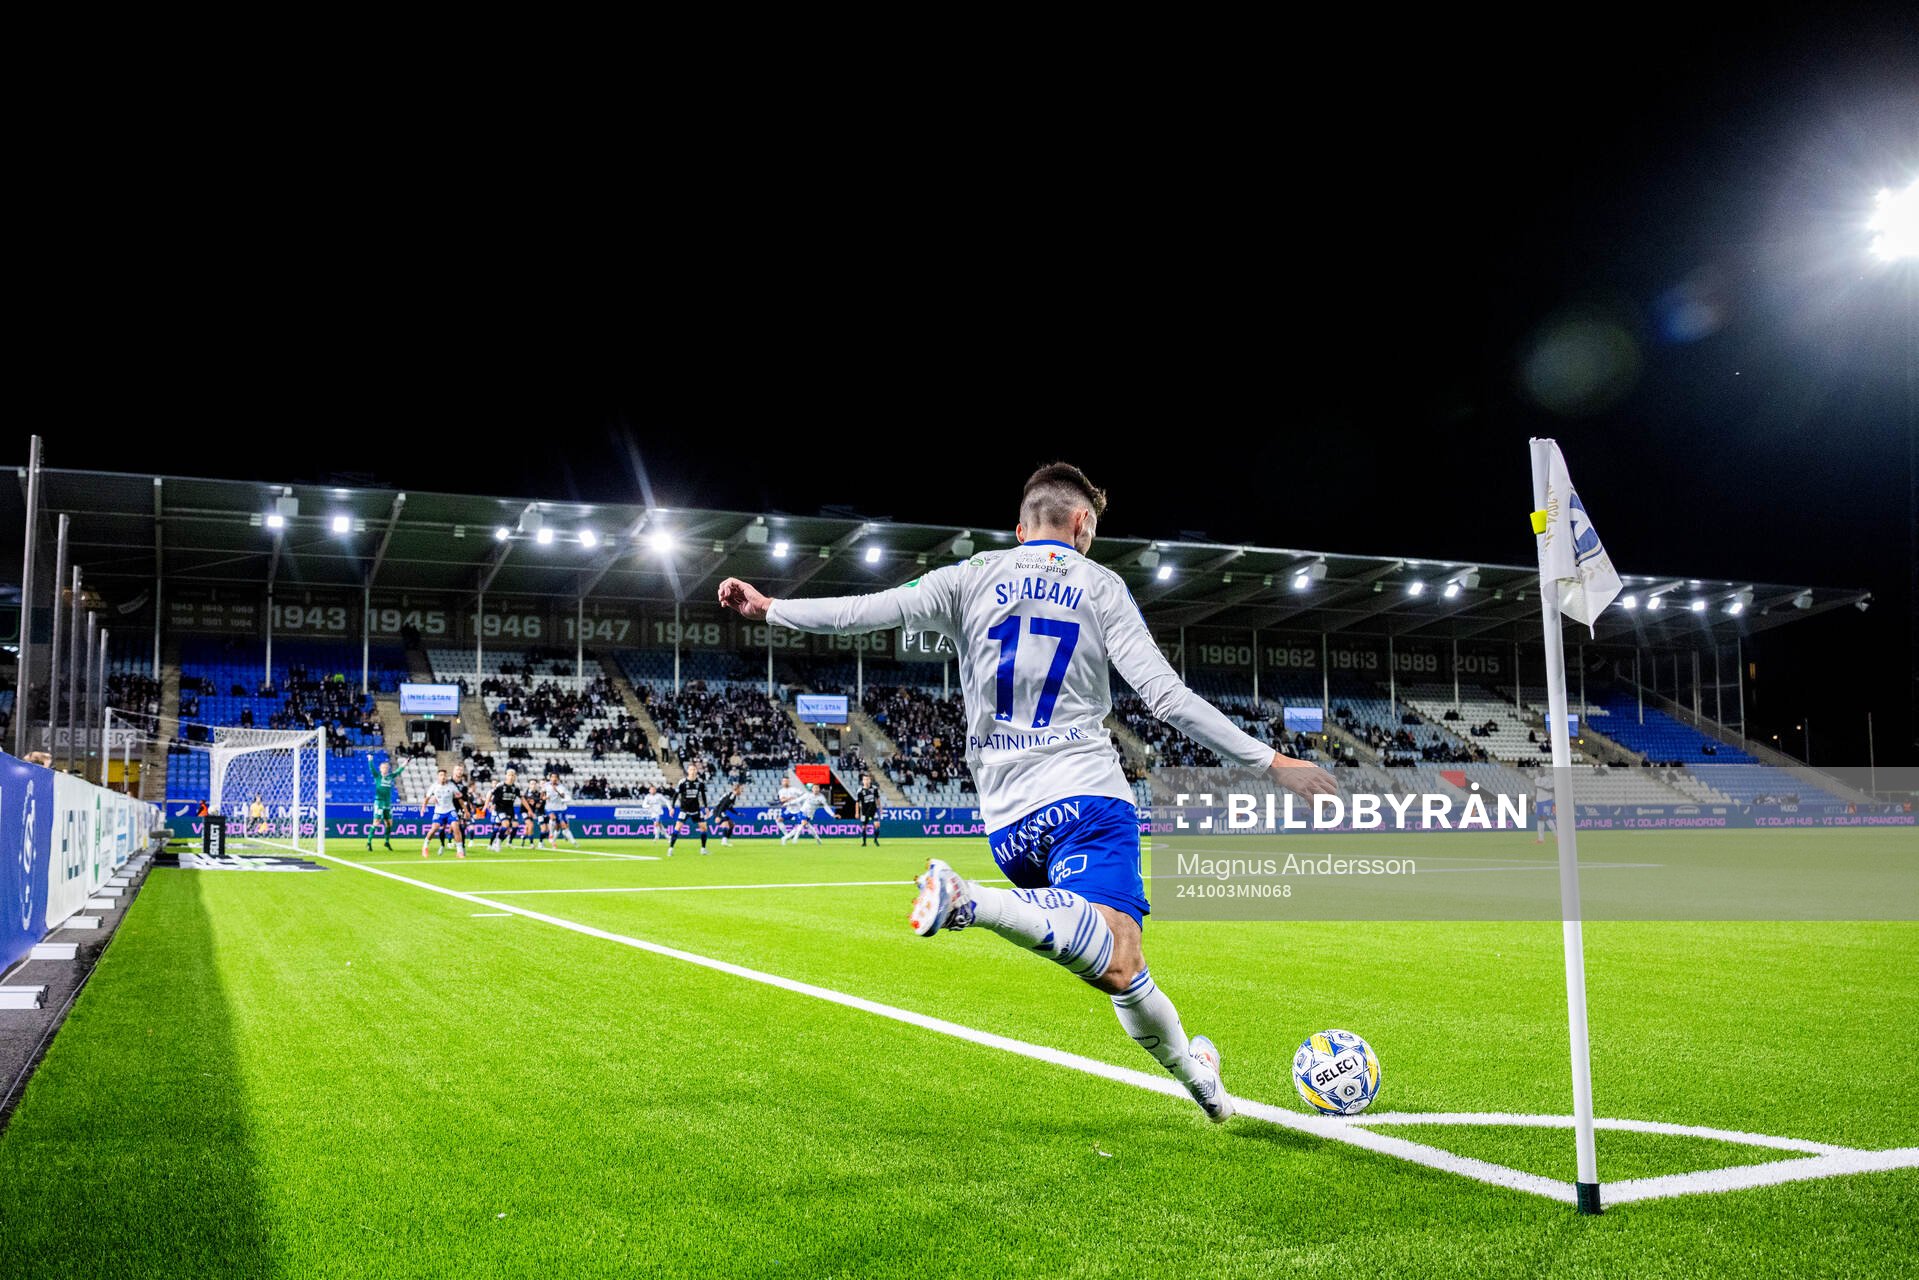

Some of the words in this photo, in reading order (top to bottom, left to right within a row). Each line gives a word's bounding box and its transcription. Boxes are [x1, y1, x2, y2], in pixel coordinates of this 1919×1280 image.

[995, 577, 1084, 610] SHABANI
[271, 604, 346, 630] 1943
[367, 608, 446, 634] 1945
[470, 613, 542, 638] 1946
[564, 617, 631, 641] 1947
[654, 621, 720, 646] 1948
[742, 625, 805, 649] 1952
[1200, 644, 1251, 665] 1960
[1266, 647, 1316, 668] 1962
[1392, 652, 1437, 673] 1989
[1452, 652, 1499, 674] 2015
[987, 615, 1081, 729] 17
[336, 823, 358, 835] VI
[583, 824, 603, 835] VI
[923, 824, 940, 835] VI
[995, 801, 1080, 865] MÅNSSON
[1316, 1055, 1359, 1087] SELECT
